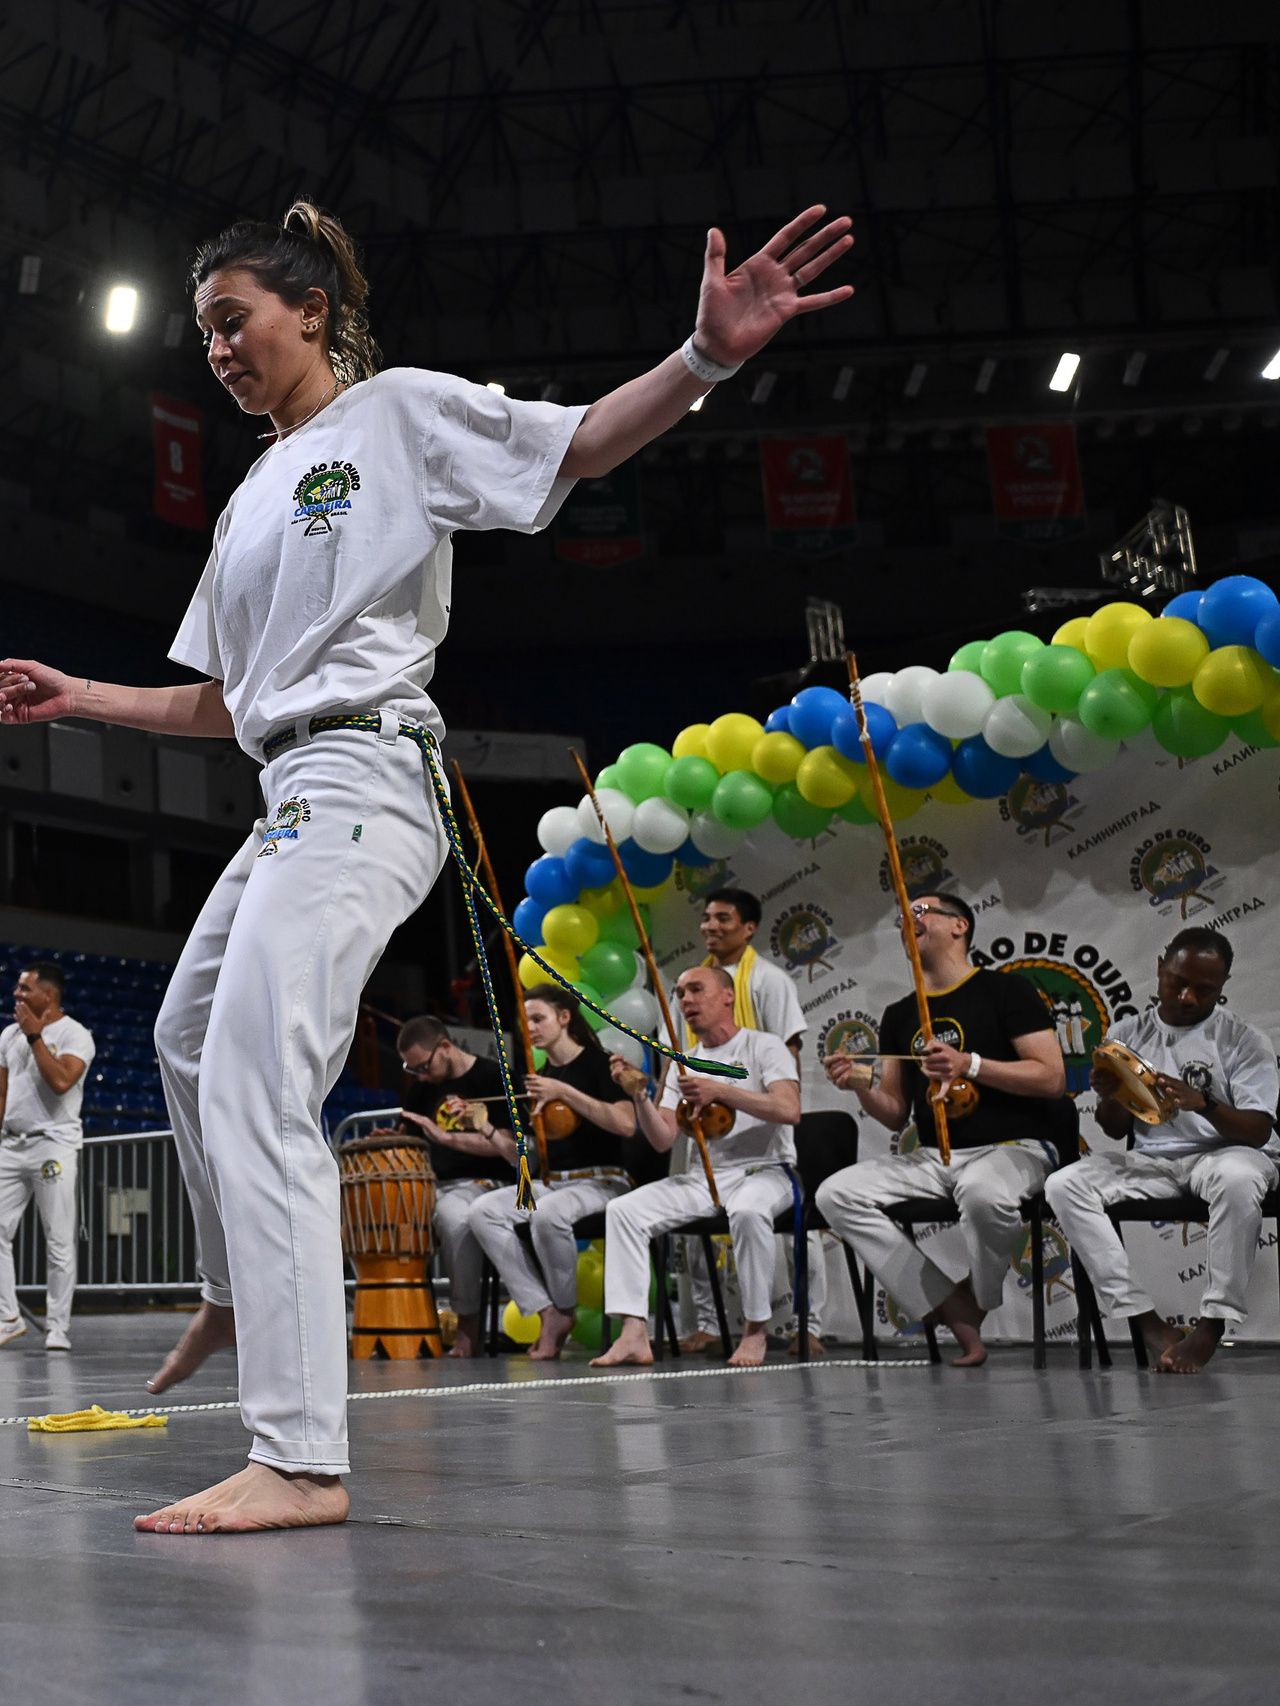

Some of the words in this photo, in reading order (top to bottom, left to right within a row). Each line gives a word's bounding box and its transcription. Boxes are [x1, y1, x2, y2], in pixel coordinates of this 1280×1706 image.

[343, 462, 361, 491] OURO
[294, 499, 352, 518] CAPOEIRA
[1067, 800, 1161, 860] КАЛИНИНГРАД
[1154, 828, 1173, 842] DE
[1176, 829, 1212, 854] OURO
[1023, 931, 1068, 957] DE
